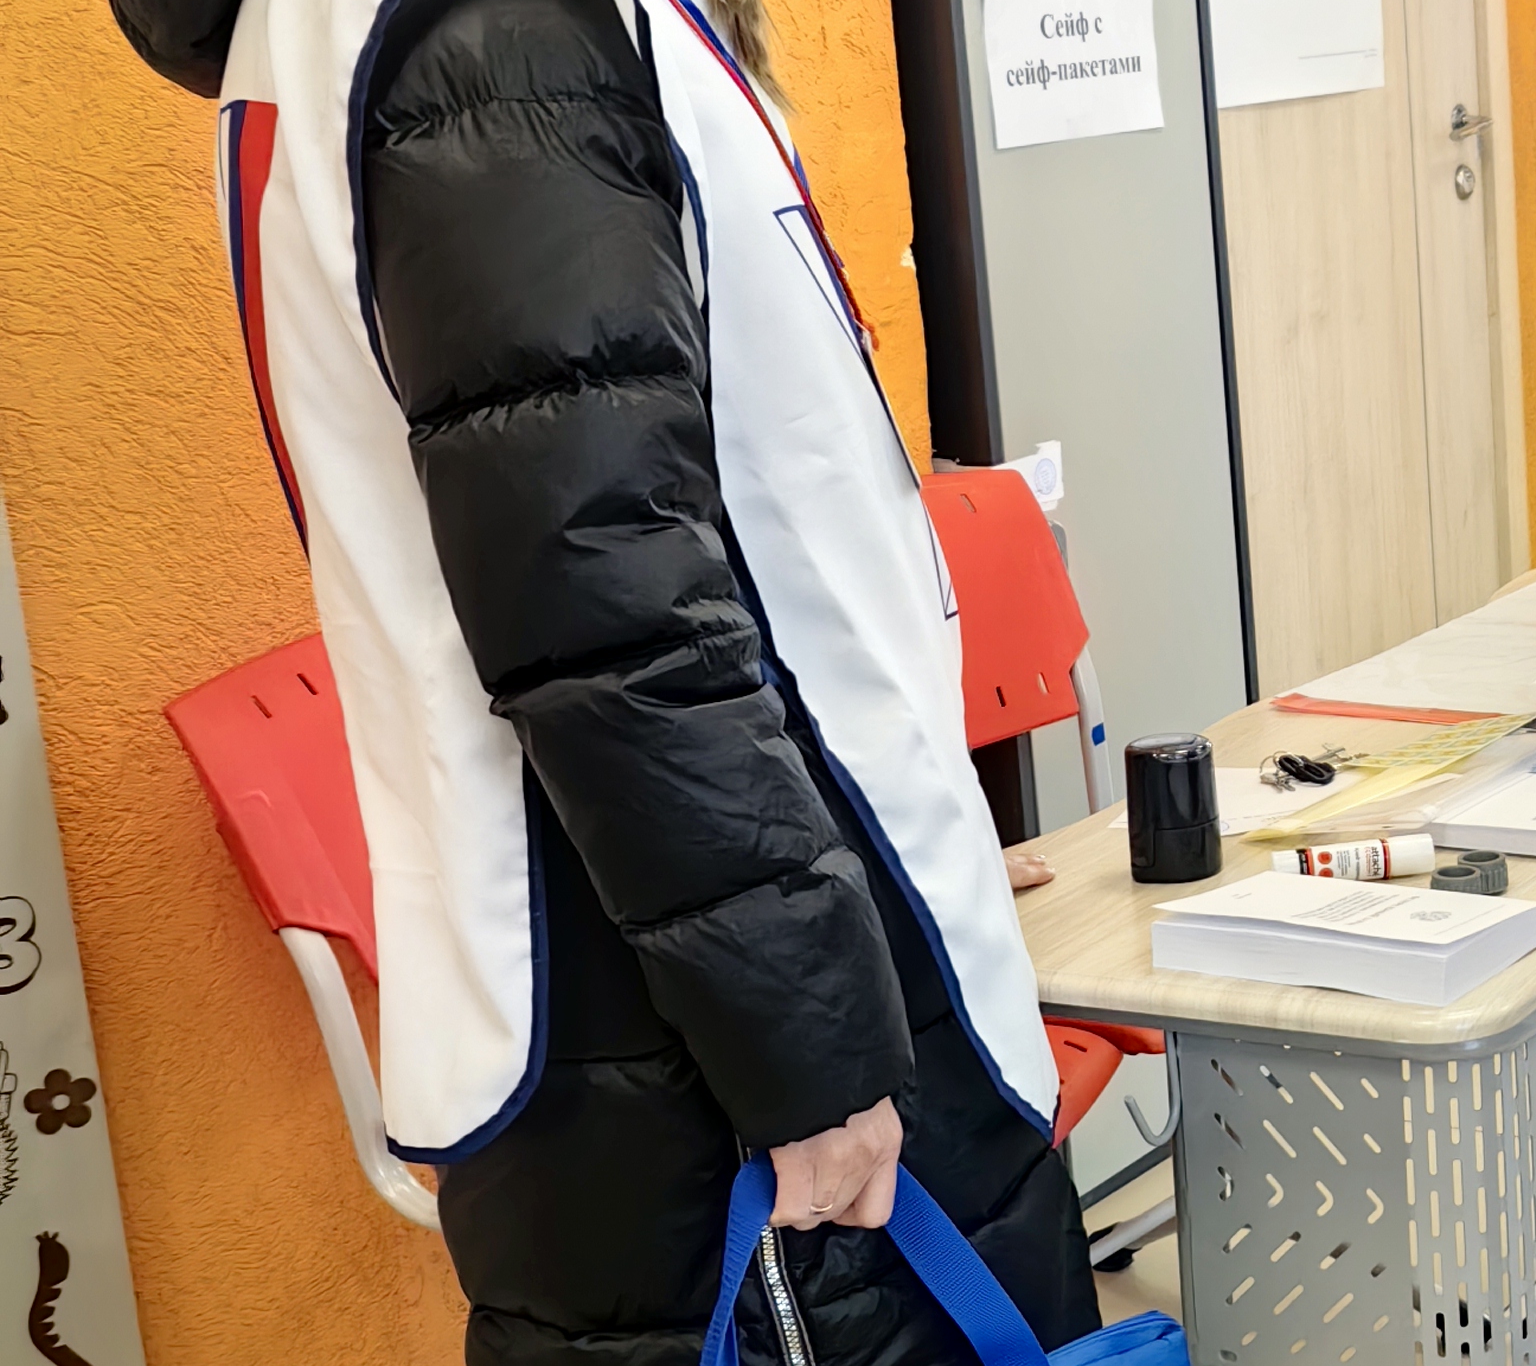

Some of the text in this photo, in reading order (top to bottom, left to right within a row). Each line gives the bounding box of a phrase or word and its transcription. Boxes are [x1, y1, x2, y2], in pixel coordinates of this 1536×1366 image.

[1040, 12, 1103, 43] Сейф с
[1006, 55, 1142, 91] сейф-пакетами
